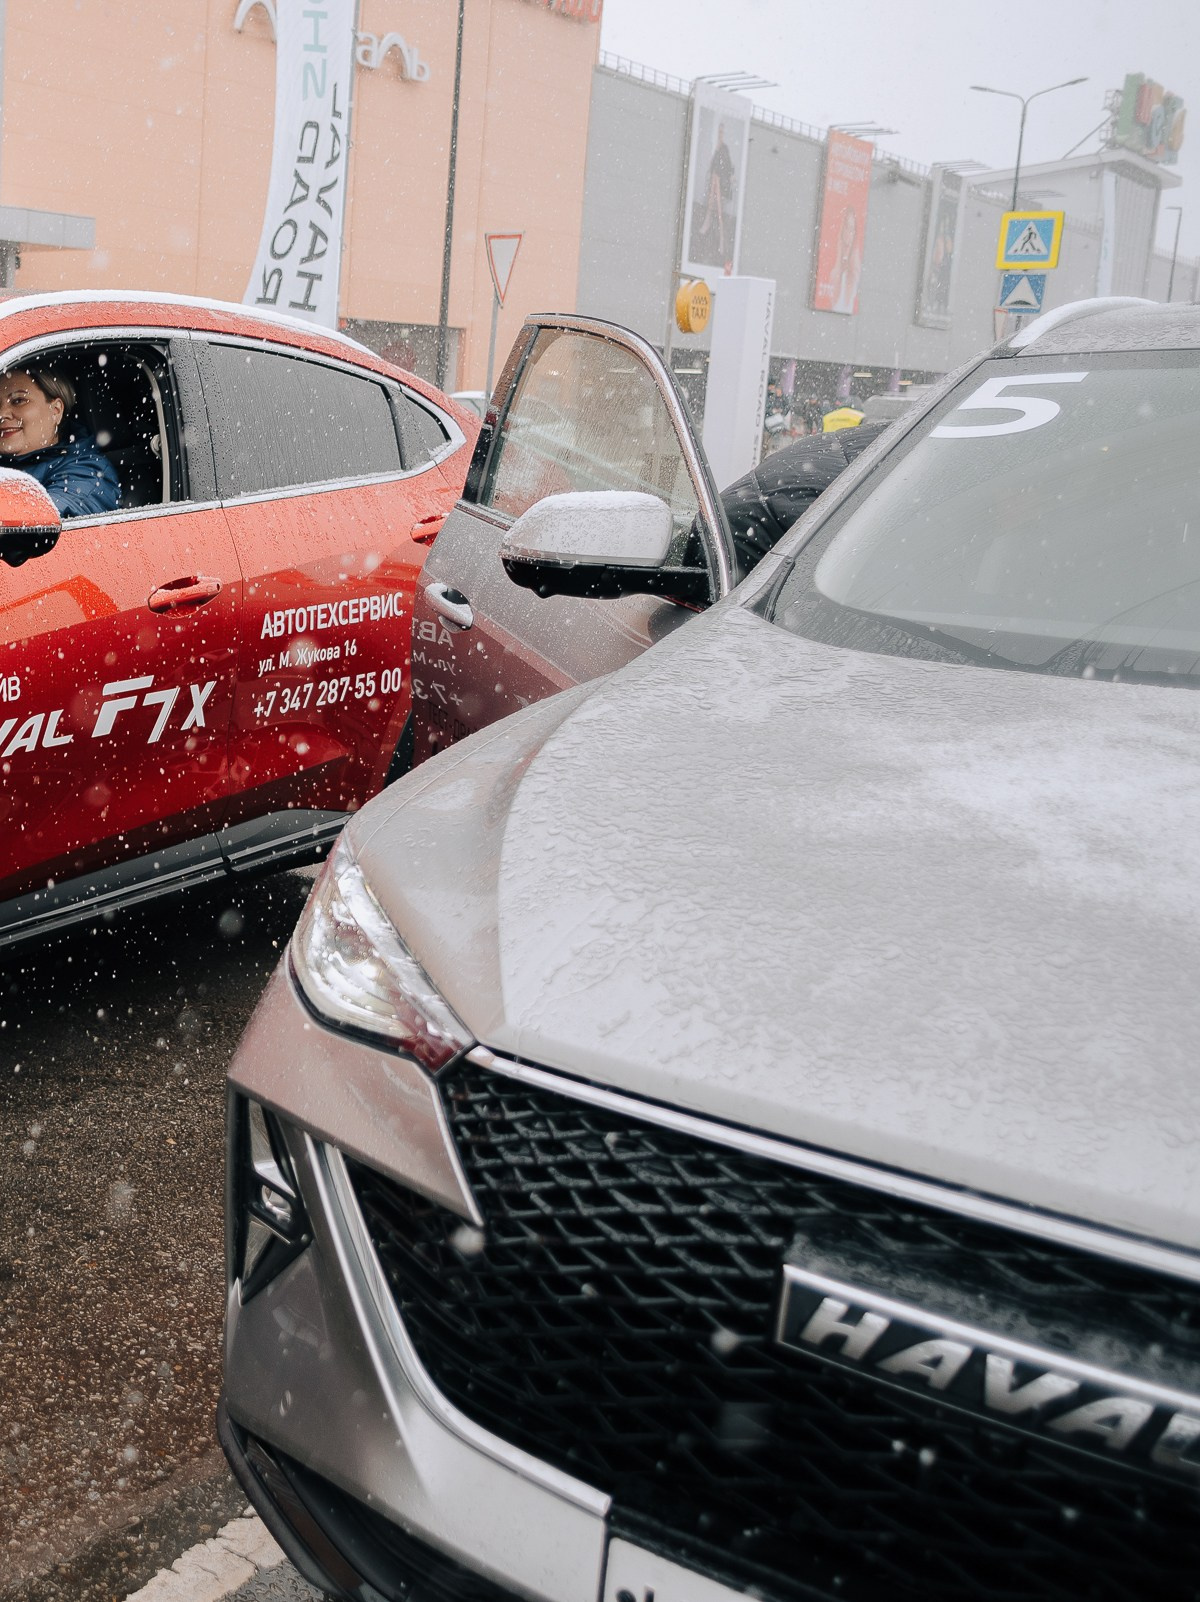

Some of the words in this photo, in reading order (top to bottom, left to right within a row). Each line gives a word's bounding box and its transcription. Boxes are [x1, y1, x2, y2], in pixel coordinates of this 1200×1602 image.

[760, 292, 773, 362] HAVAL
[755, 369, 765, 428] ROAD
[928, 372, 1090, 438] 5
[260, 592, 404, 640] АВТОТЕХСЕРВИС
[258, 660, 276, 678] ул.
[279, 652, 293, 669] М.
[295, 646, 341, 668] Жукова
[344, 639, 357, 657] 16
[254, 691, 277, 718] +7
[279, 683, 314, 714] 347
[380, 667, 402, 694] 00
